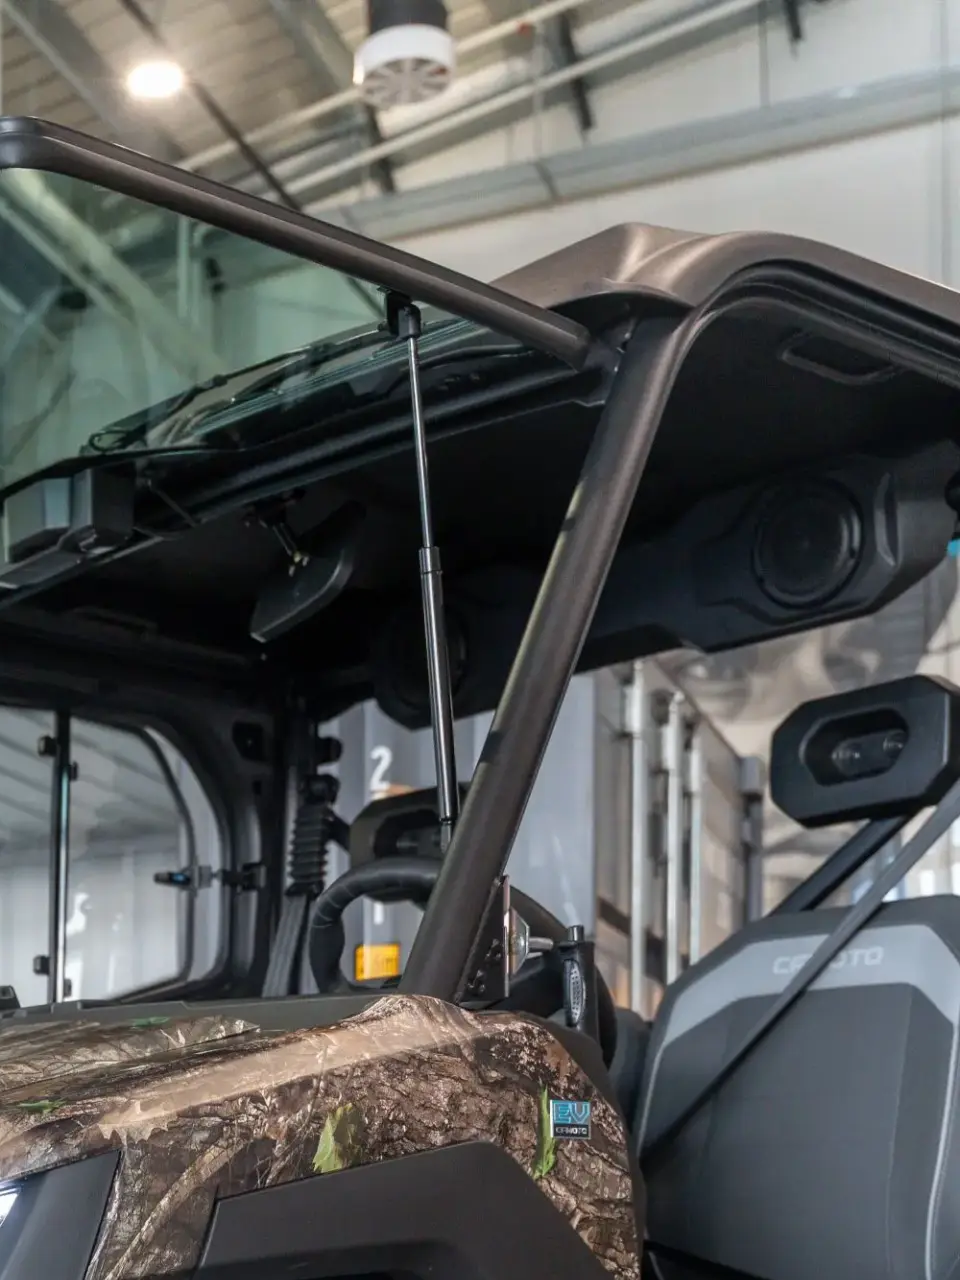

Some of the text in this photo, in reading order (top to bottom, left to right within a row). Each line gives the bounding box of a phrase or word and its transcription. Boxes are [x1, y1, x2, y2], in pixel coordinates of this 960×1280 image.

[370, 745, 392, 792] 2
[772, 945, 884, 975] CFOTO
[553, 1101, 590, 1124] EV
